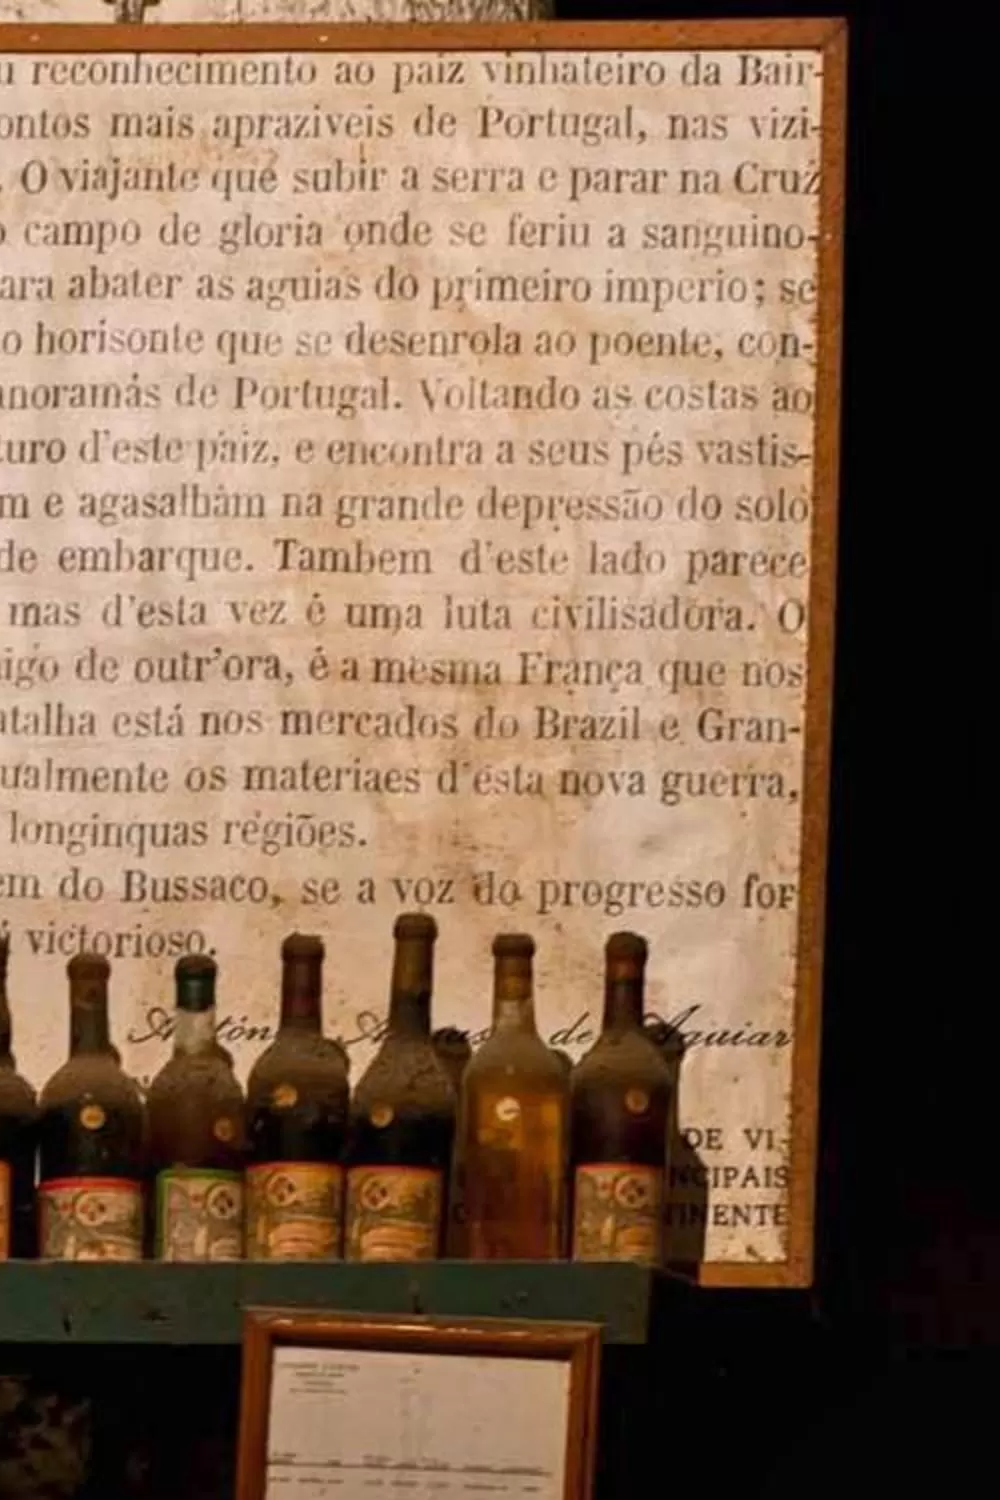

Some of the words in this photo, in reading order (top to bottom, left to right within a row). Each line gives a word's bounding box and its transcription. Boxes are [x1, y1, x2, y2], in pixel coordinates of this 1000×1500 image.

[31, 52, 318, 85] reconhecimento
[392, 55, 466, 94] paiz
[483, 52, 667, 84] vinhateiro
[108, 109, 195, 138] mais
[211, 109, 396, 148] apraziveis
[477, 106, 649, 148] Portugal,
[667, 114, 729, 138] nas
[747, 109, 819, 138] vizi-
[18, 160, 49, 192] O
[55, 163, 202, 202] viajante
[291, 160, 389, 193] subir
[431, 169, 526, 193] serra
[568, 169, 669, 203] parar
[22, 223, 143, 256] campo
[217, 214, 324, 256] gloria
[343, 214, 434, 247] onde
[507, 214, 591, 247] feriu
[641, 217, 816, 257] sanguino-
[66, 268, 184, 300] abater
[245, 271, 363, 310] aguias
[431, 271, 593, 311] primeiro
[603, 272, 767, 312] imperio;
[34, 321, 206, 354] horisonte
[215, 331, 284, 364] que
[343, 322, 522, 355] desenrola
[586, 326, 725, 366] poente,
[736, 332, 813, 356] con-
[232, 376, 404, 419] Portugal.
[418, 377, 582, 410] Voltando
[591, 386, 634, 410] as
[643, 381, 760, 411] costas
[325, 434, 484, 464] encontra
[526, 441, 611, 465] seus
[621, 432, 686, 475] pés
[695, 435, 810, 466] vastis-
[333, 485, 465, 529] grande
[475, 486, 665, 530] depressão
[56, 538, 256, 583] embarque.
[276, 540, 434, 574] Tambem
[588, 542, 667, 575] lado
[686, 551, 807, 586] parece
[7, 602, 83, 626] mas
[224, 603, 288, 628] vez
[342, 604, 424, 629] uma
[530, 596, 767, 631] civilisadora.
[776, 598, 805, 632] O
[74, 647, 121, 680] de
[515, 651, 644, 692] França
[657, 661, 726, 696] que
[111, 702, 186, 736] está
[198, 712, 265, 737] nos
[278, 704, 460, 739] mercados
[472, 706, 521, 739] do
[533, 706, 642, 741] Brazil
[695, 708, 801, 742] Gran-
[242, 762, 422, 794] materiaes
[558, 770, 648, 797] nova
[8, 812, 210, 858] longinquas
[118, 868, 288, 910] Bussaco,
[387, 880, 456, 905] voz
[536, 882, 727, 919] progresso
[743, 875, 796, 909] for
[27, 921, 217, 958] victorioso.
